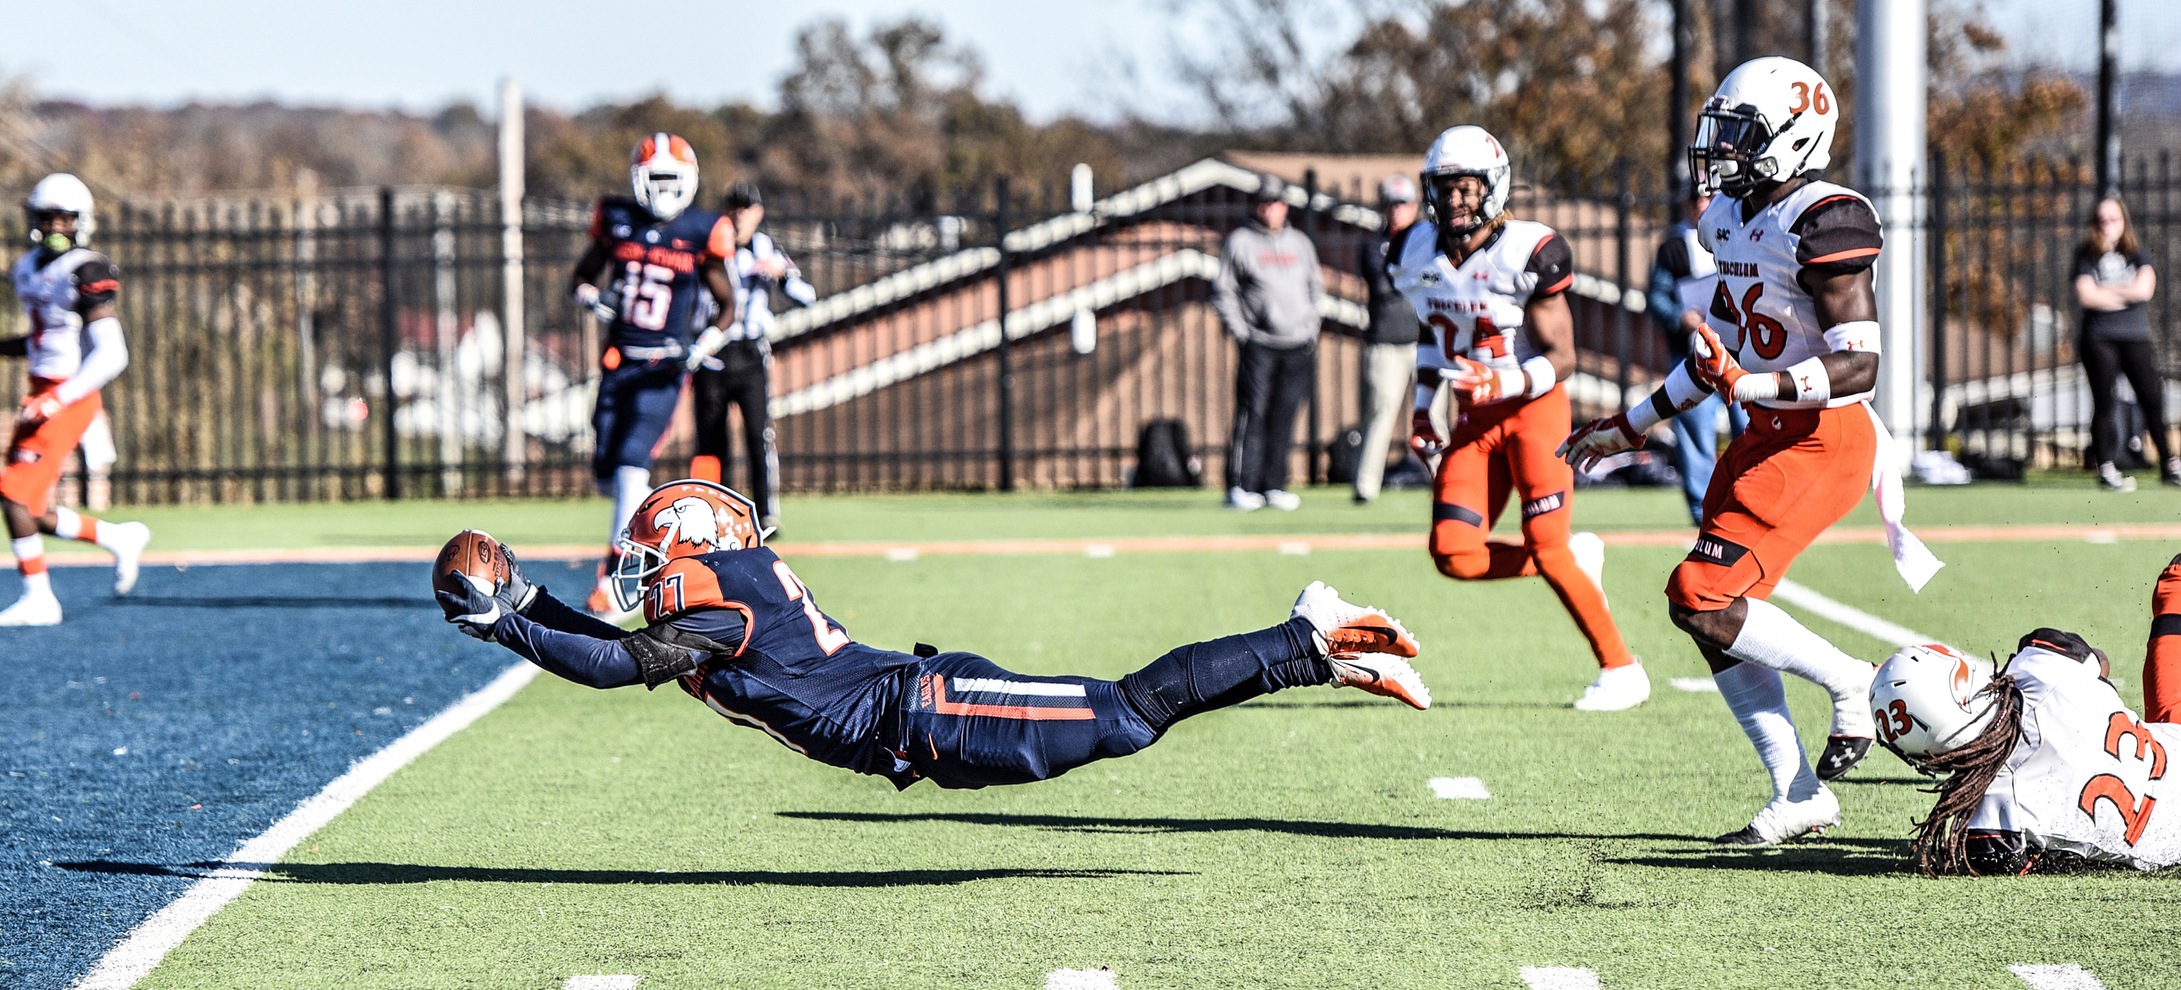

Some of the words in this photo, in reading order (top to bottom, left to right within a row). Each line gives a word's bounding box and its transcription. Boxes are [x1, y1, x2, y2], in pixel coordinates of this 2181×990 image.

[1789, 81, 1831, 116] 36
[1718, 260, 1760, 278] TUSCULUM
[621, 260, 675, 331] 15
[1428, 312, 1509, 360] 24
[649, 571, 686, 620] 27
[920, 674, 933, 709] EAGLES
[1875, 699, 1913, 742] 23
[2078, 711, 2168, 848] 23
